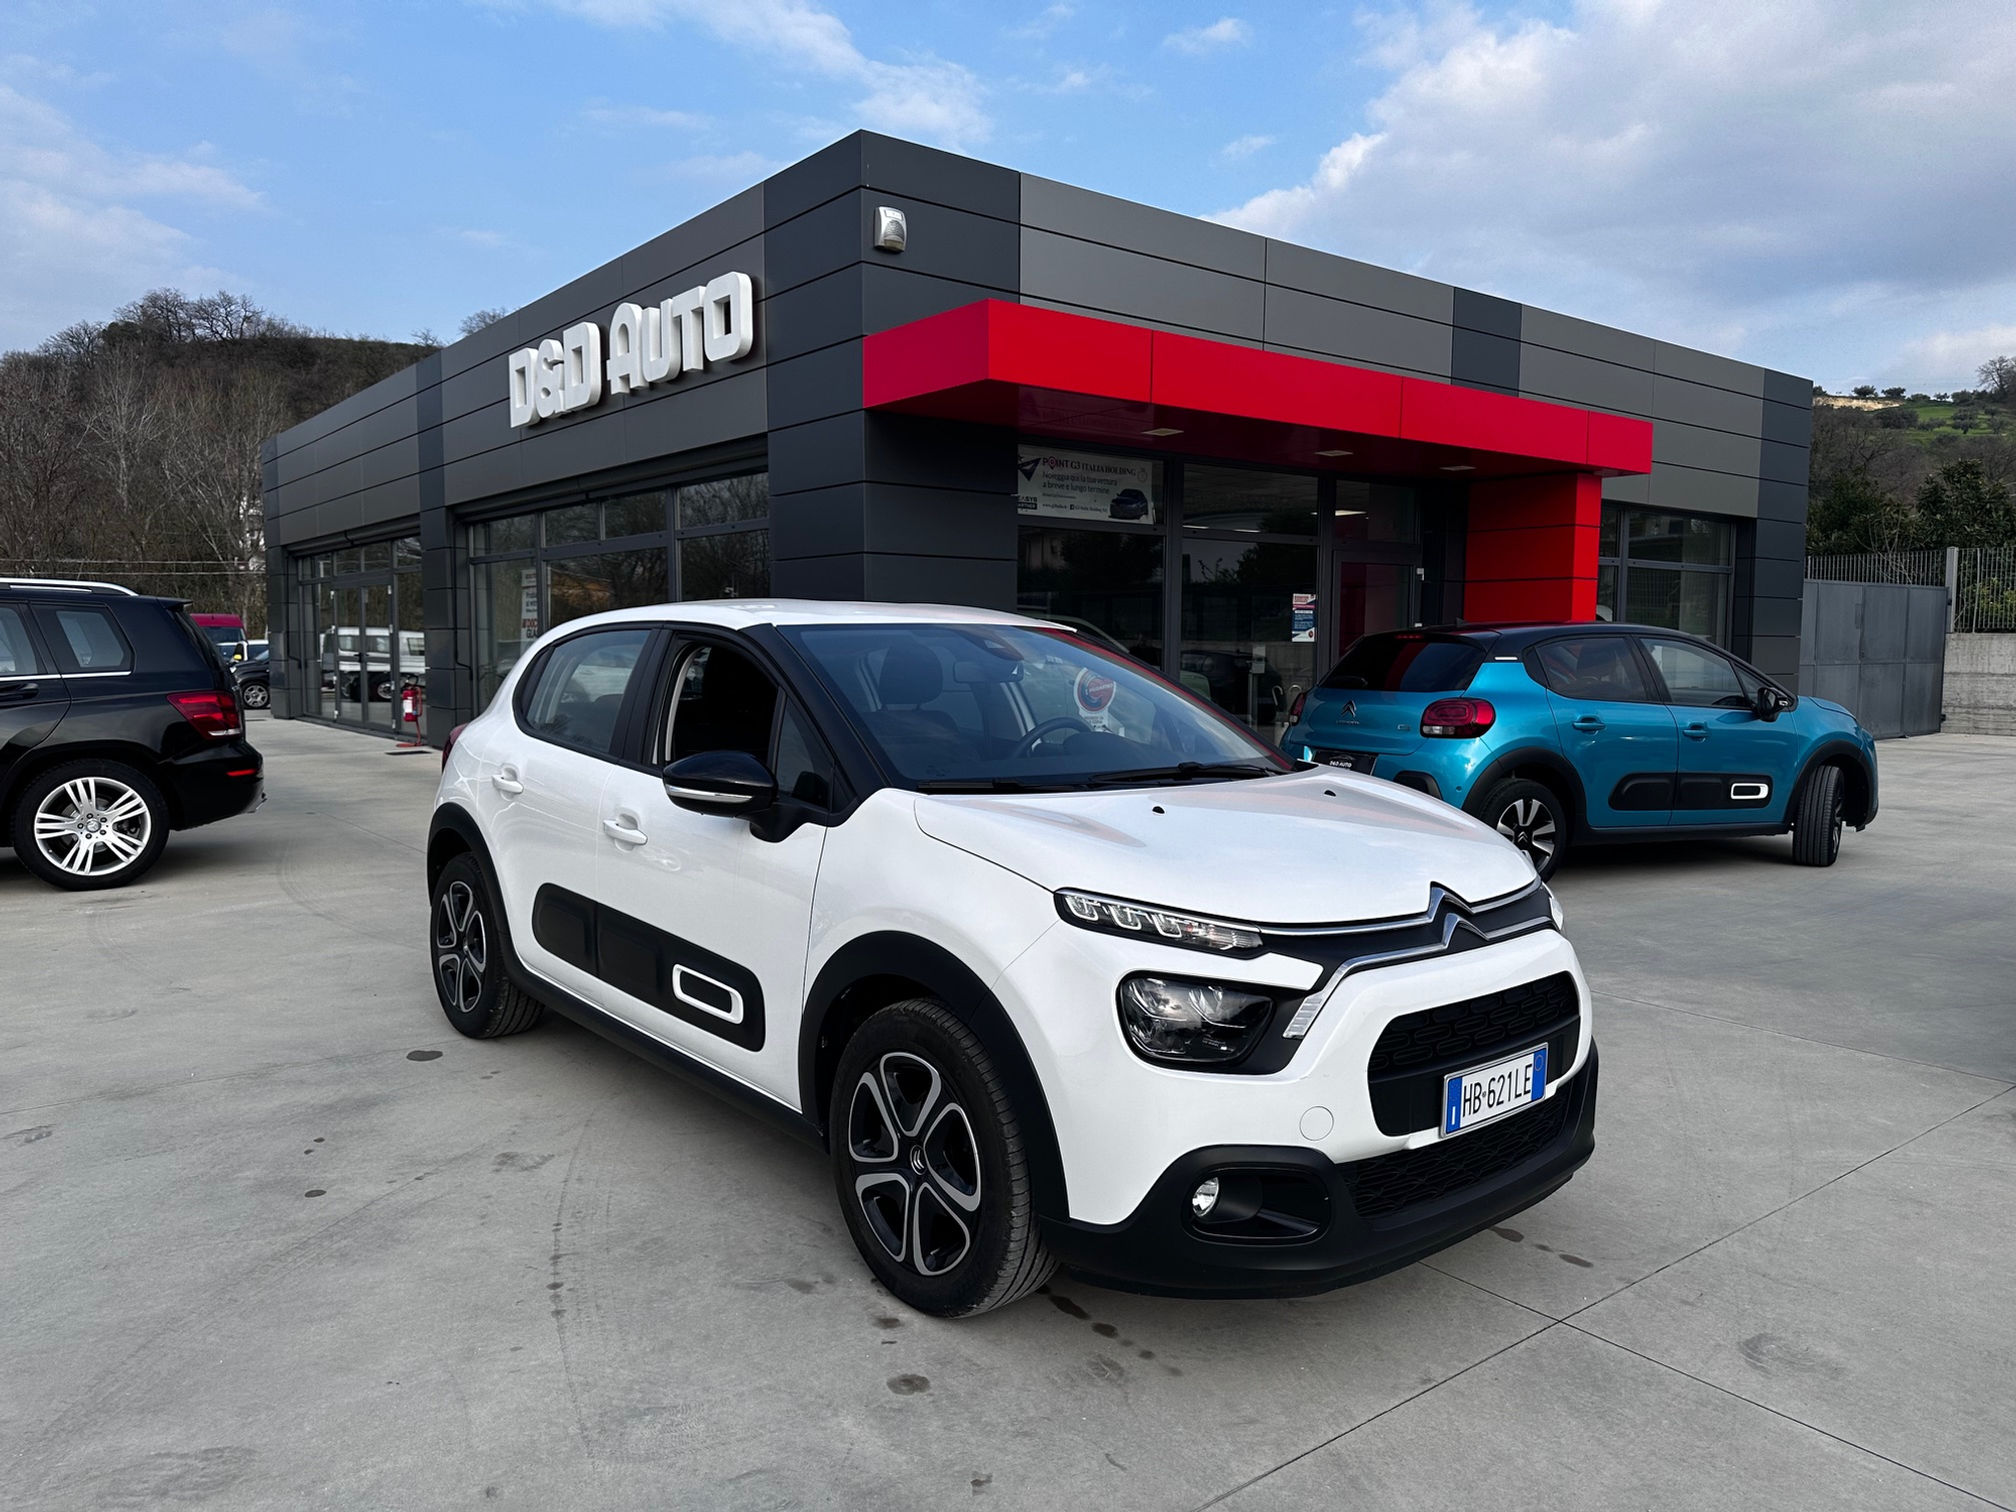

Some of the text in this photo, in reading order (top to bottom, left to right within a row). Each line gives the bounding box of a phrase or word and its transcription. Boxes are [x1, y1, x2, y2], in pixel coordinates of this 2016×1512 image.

[509, 322, 601, 428] D&D
[1043, 456, 1136, 476] POINT G3 ITALIA HOLDING
[1048, 480, 1064, 490] breve
[1071, 482, 1086, 493] lungo
[1087, 485, 1110, 494] termine
